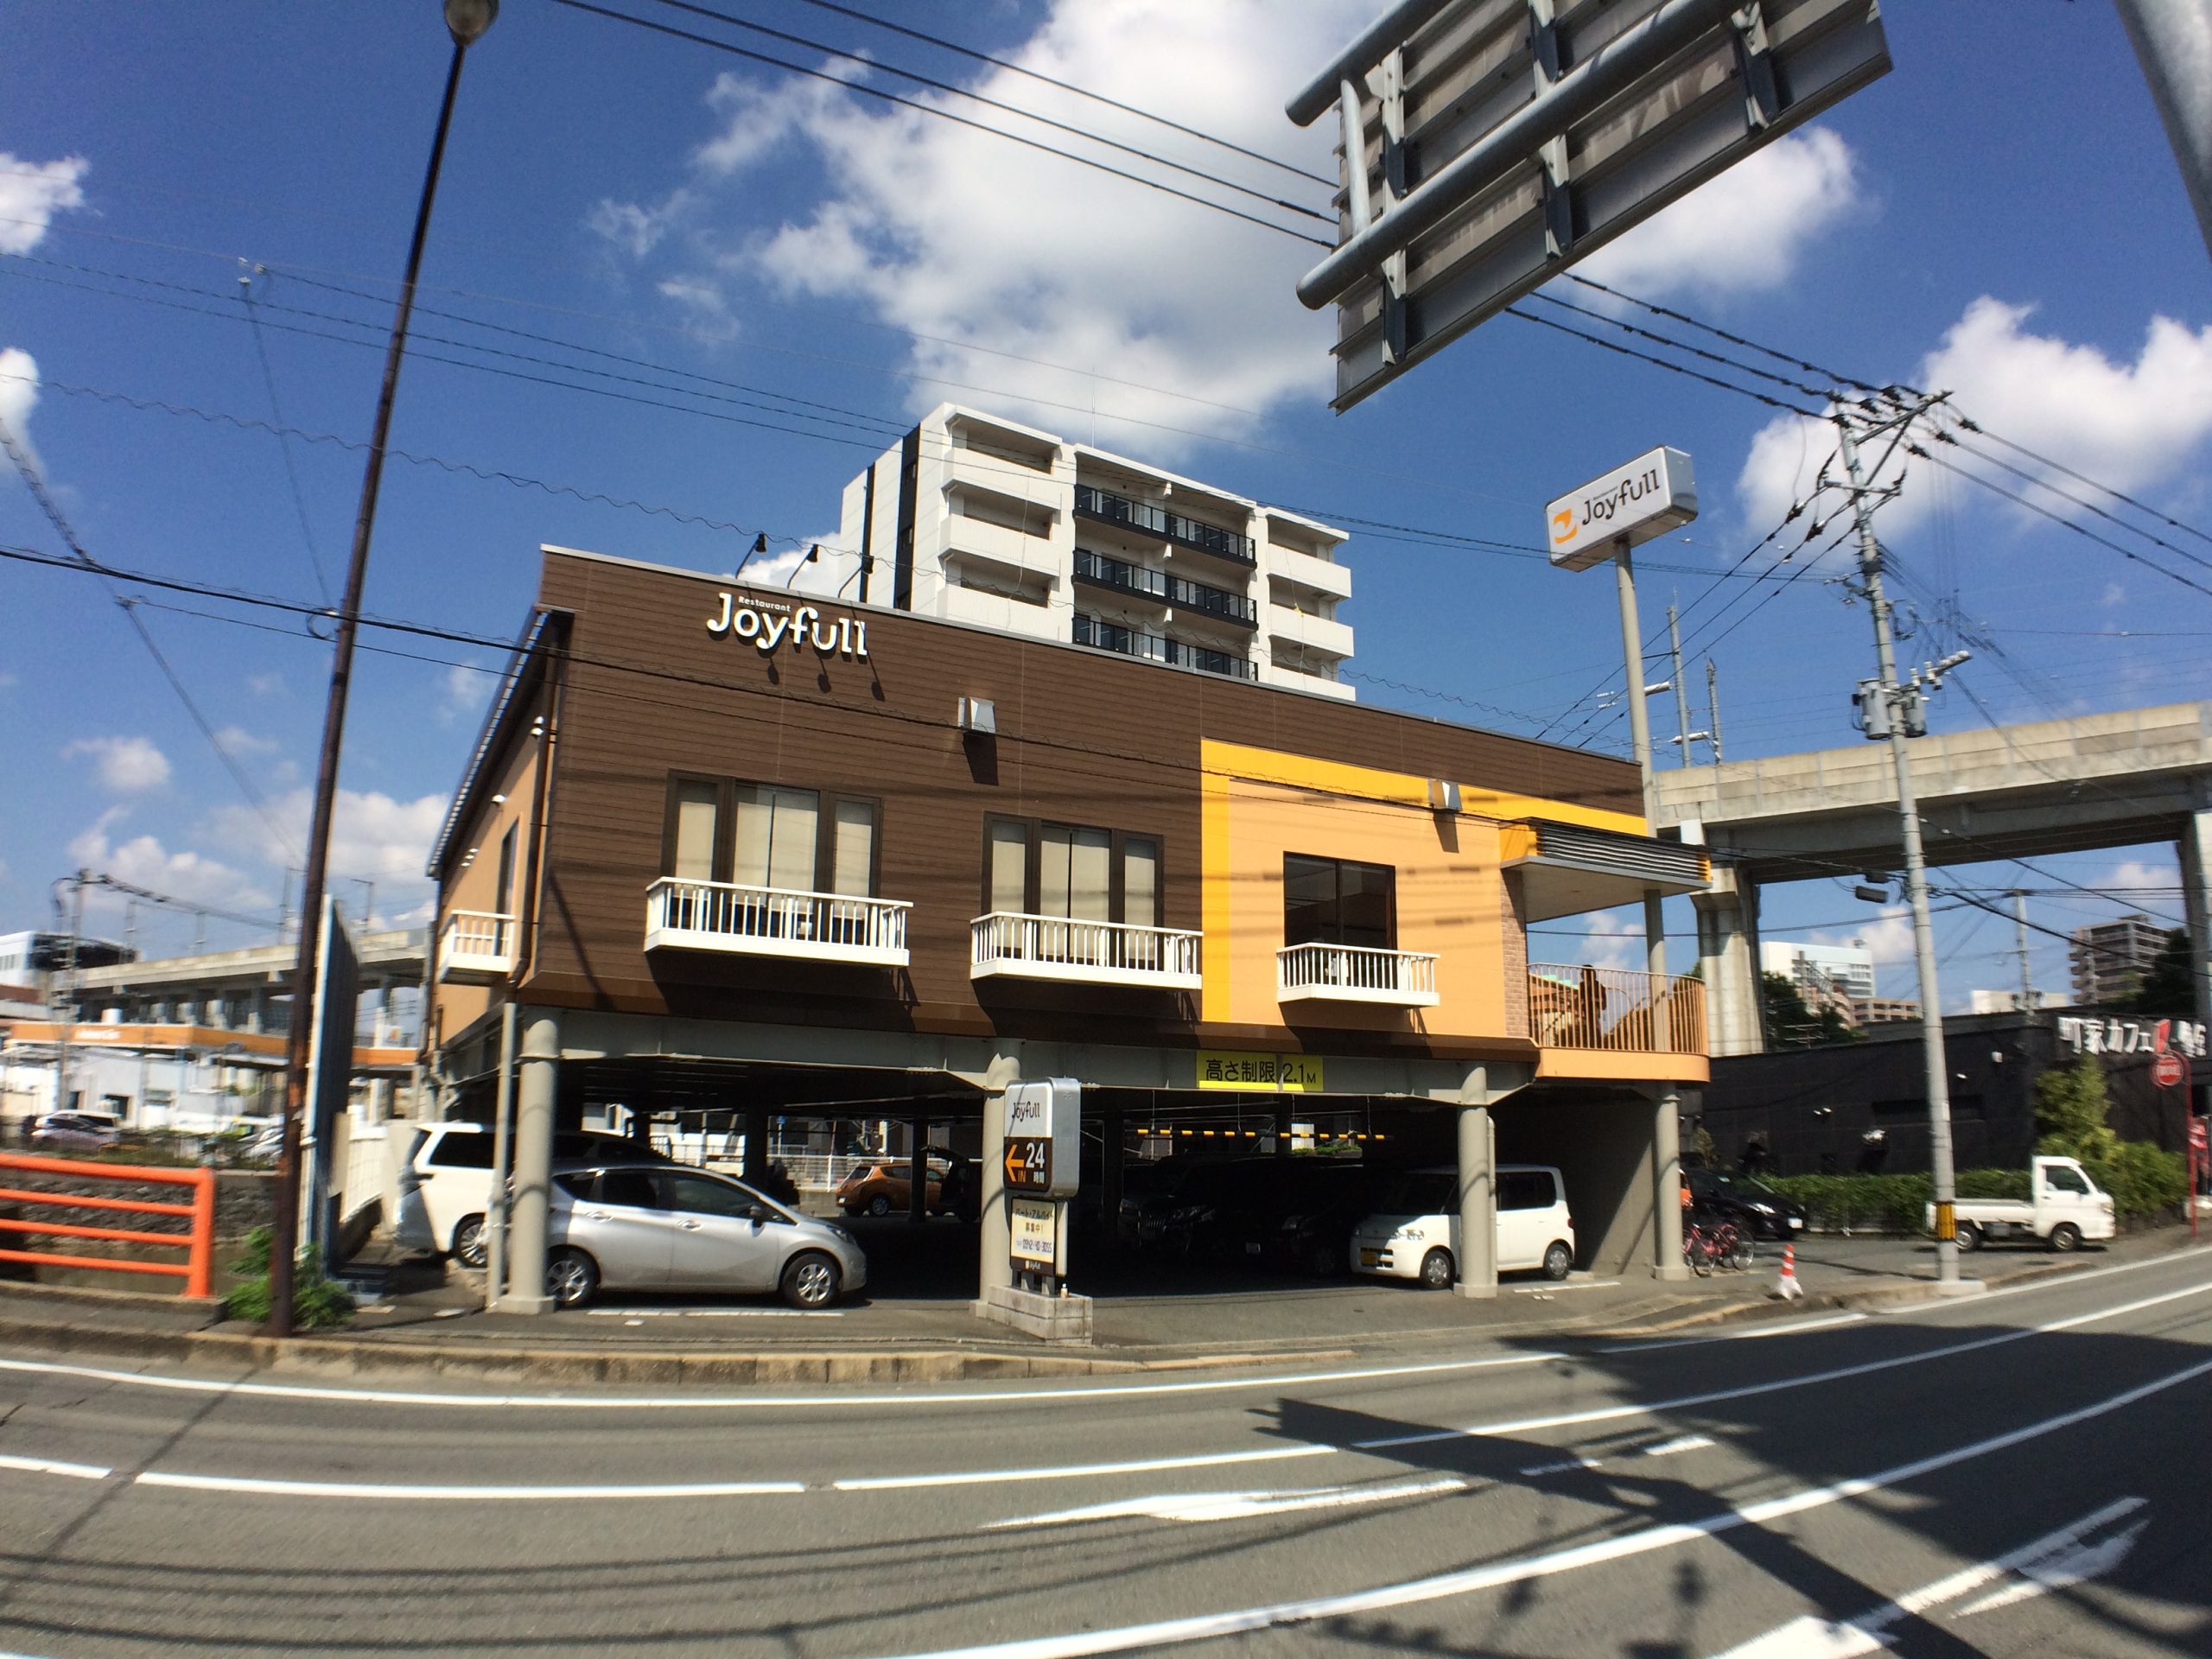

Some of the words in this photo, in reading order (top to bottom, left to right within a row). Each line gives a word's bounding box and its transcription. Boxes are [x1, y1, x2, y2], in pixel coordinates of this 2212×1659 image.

[1582, 469, 1661, 525] Joyfull
[738, 595, 791, 613] Restaurant
[706, 593, 868, 656] Joyfull
[1206, 1058, 1275, 1083] 高さ制限
[1012, 1101, 1040, 1122] Joyfull
[1026, 1142, 1045, 1169] 24
[1018, 1170, 1027, 1183] IN
